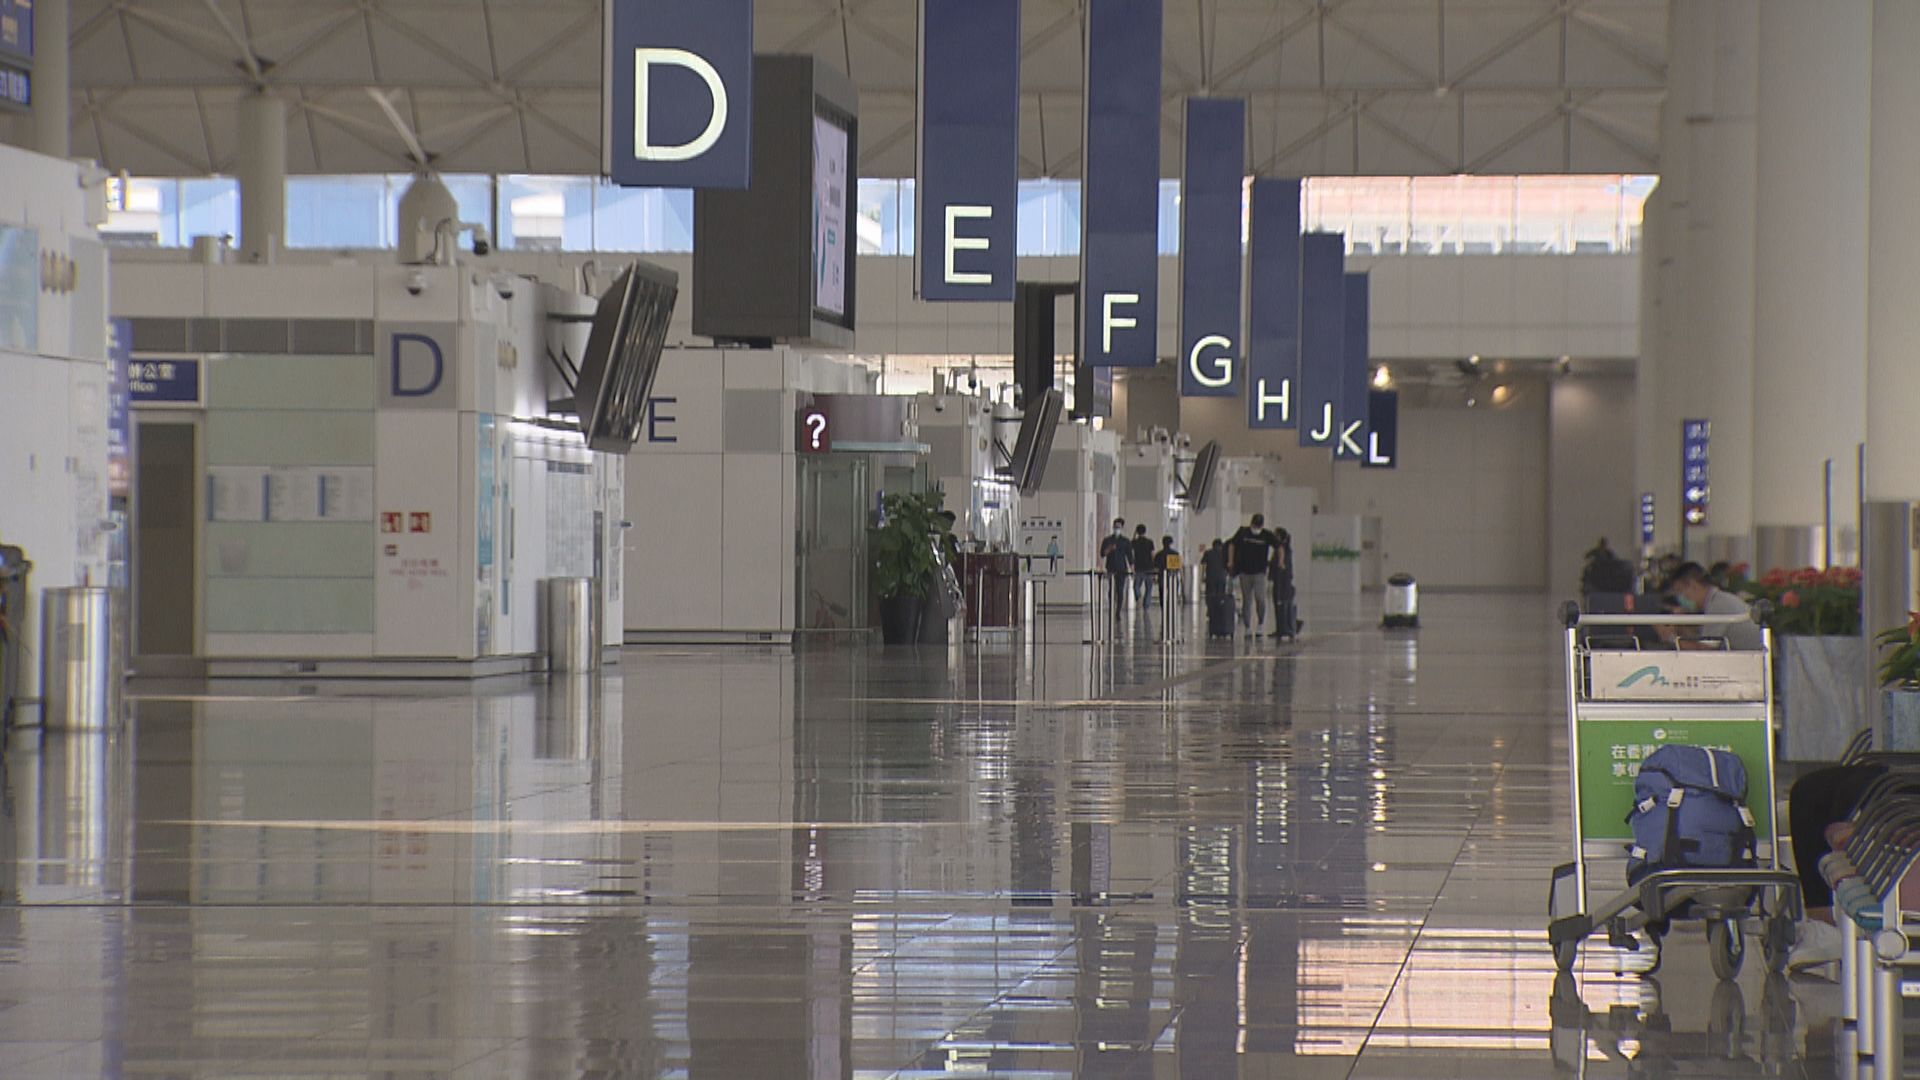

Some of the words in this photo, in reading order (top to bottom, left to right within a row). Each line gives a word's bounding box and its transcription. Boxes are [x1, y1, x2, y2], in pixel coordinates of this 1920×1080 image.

[634, 47, 728, 161] D
[944, 205, 993, 284] E
[1102, 293, 1139, 354] F
[391, 333, 443, 397] D
[1189, 335, 1232, 388] G
[128, 380, 157, 393] ffice
[1257, 378, 1290, 422] H
[648, 397, 677, 442] E
[1310, 402, 1332, 442] J
[1336, 420, 1363, 456] K
[1368, 431, 1390, 464] L
